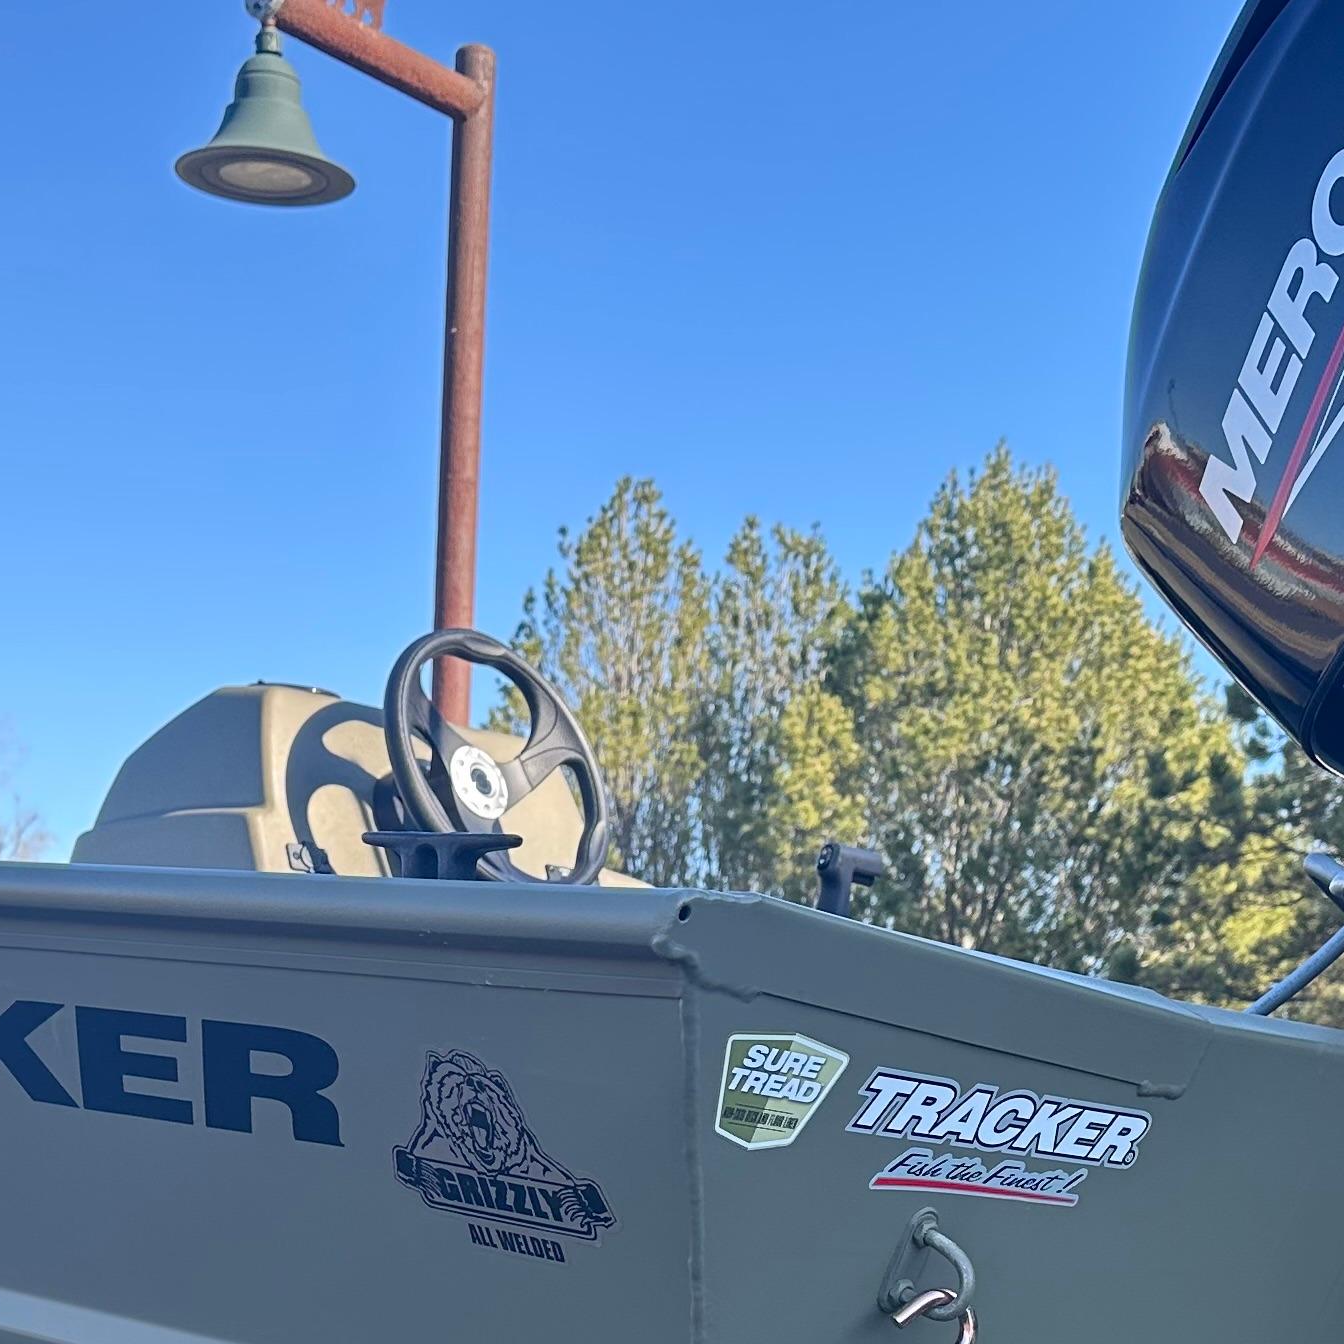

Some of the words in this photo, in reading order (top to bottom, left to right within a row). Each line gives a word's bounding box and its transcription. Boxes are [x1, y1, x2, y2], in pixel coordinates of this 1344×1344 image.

[743, 1044, 827, 1079] SURE
[728, 1067, 822, 1103] TREAD
[888, 1153, 945, 1178] Fish
[946, 1160, 983, 1183] the
[436, 1167, 564, 1222] GRIZZLY
[468, 1223, 498, 1249] ALL
[496, 1229, 566, 1263] WELDED
